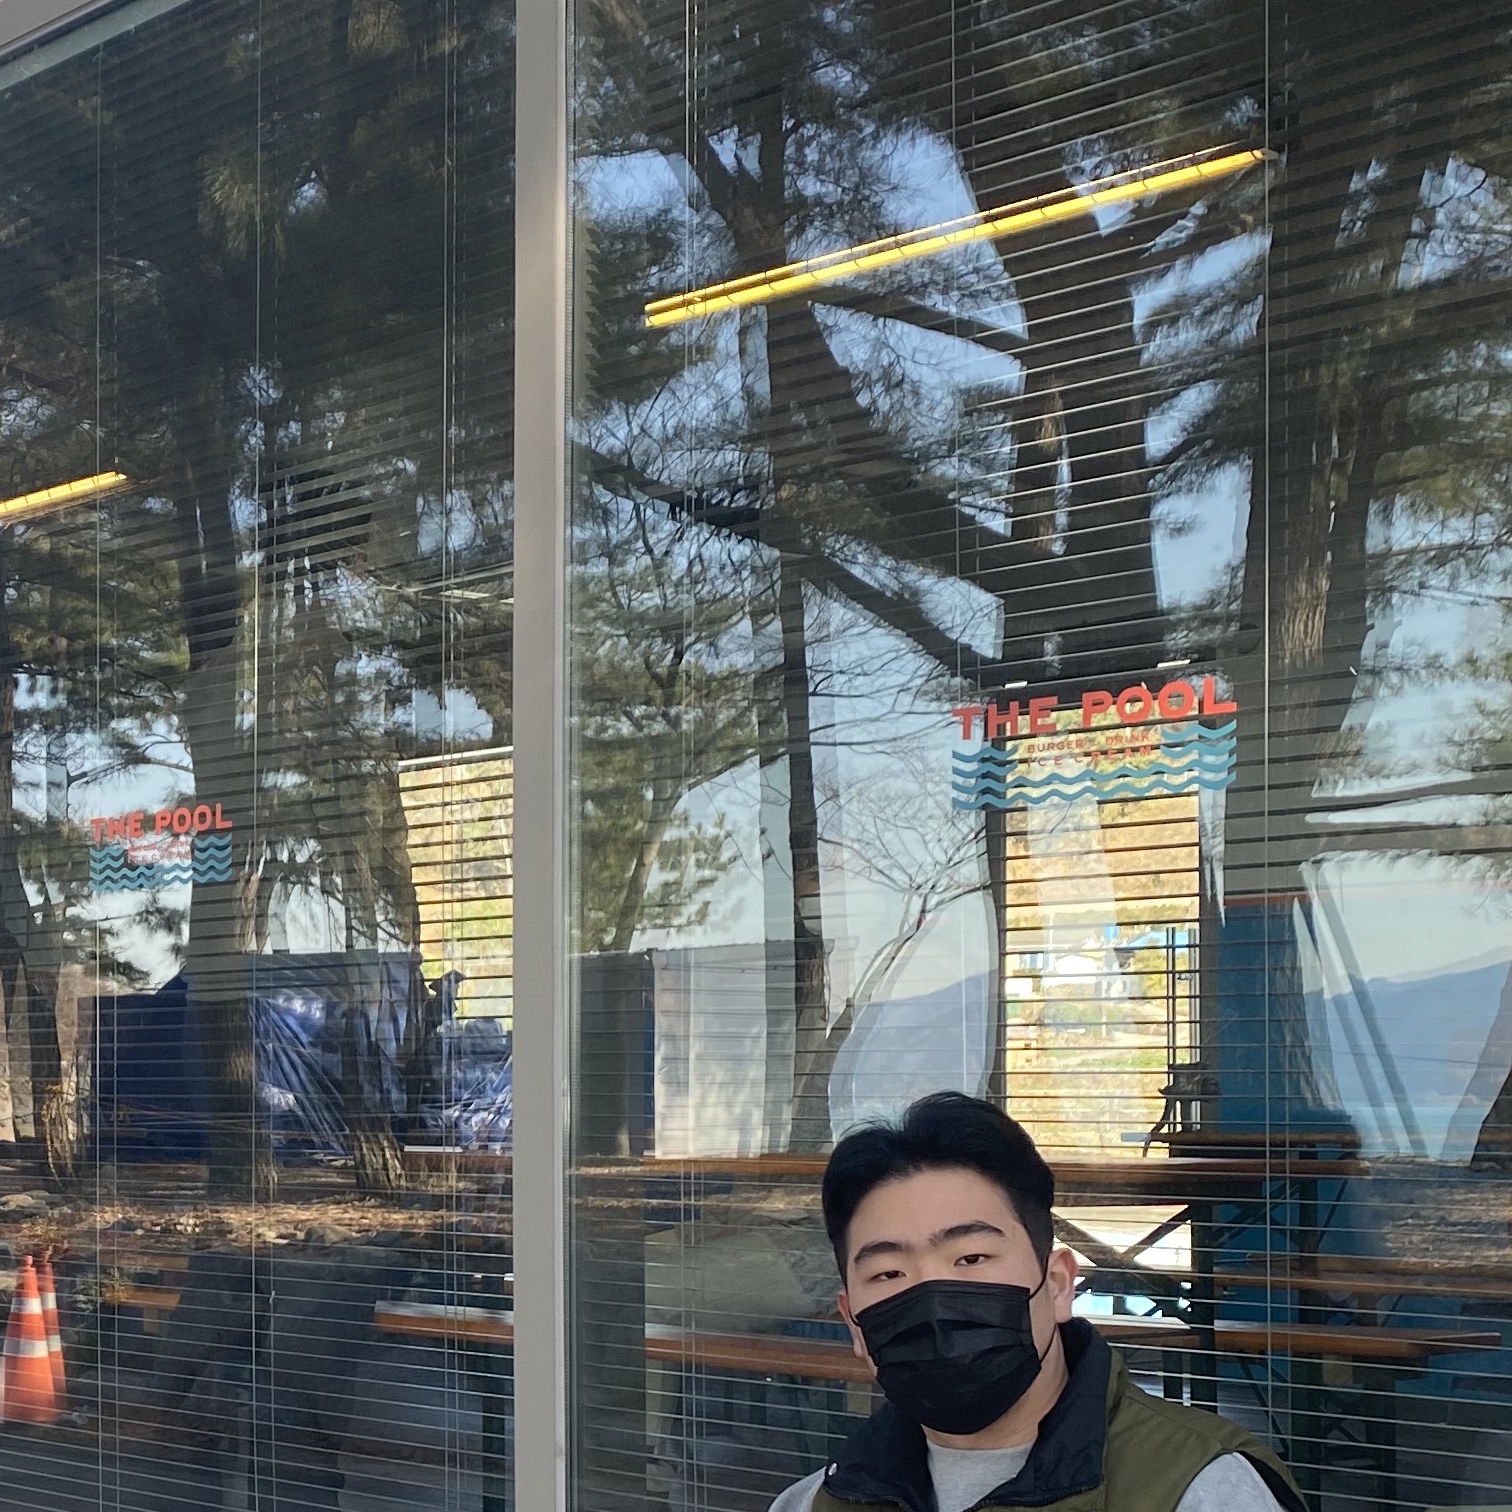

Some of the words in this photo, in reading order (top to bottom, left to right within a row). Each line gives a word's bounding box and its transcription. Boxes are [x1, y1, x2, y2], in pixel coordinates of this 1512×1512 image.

[952, 696, 1059, 740] THE
[1082, 677, 1238, 728] POOL
[1028, 739, 1084, 754] BURGER
[90, 811, 145, 844] THE
[155, 803, 233, 835] POOL
